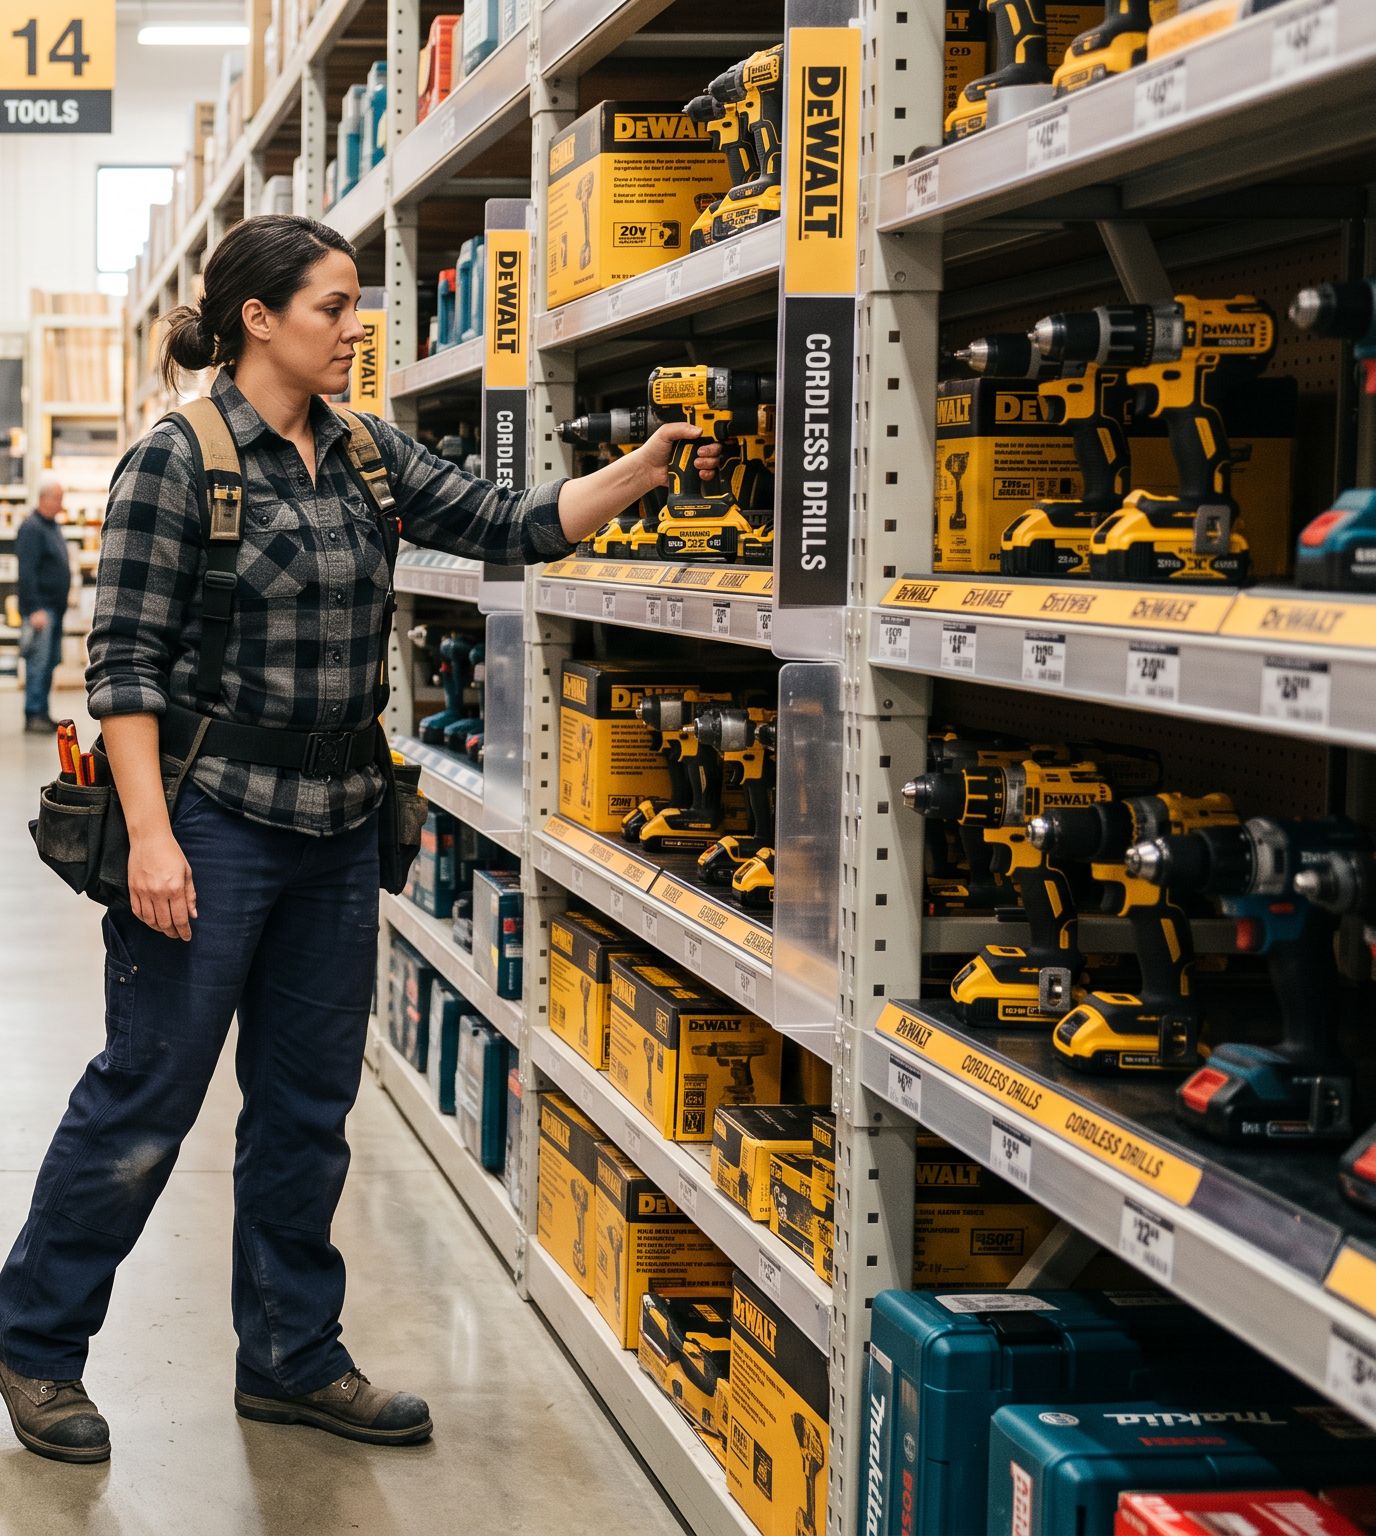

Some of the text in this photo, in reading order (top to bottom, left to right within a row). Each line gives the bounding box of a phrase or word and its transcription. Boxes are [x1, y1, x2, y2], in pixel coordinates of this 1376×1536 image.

[12, 18, 90, 76] 14
[4, 99, 79, 125] TOOLS
[613, 116, 711, 139] DEWAL
[620, 225, 647, 236] 20V
[496, 250, 519, 354] DEWALT
[937, 397, 971, 423] WALT
[496, 410, 514, 491] CORDLES
[800, 333, 831, 571] CORDLESS DRILLS
[961, 1054, 1007, 1091] CORDLESS
[1065, 1111, 1165, 1180] CORDLESS DRILLS
[916, 1165, 982, 1185] WALT
[733, 1290, 776, 1351] DEWALT
